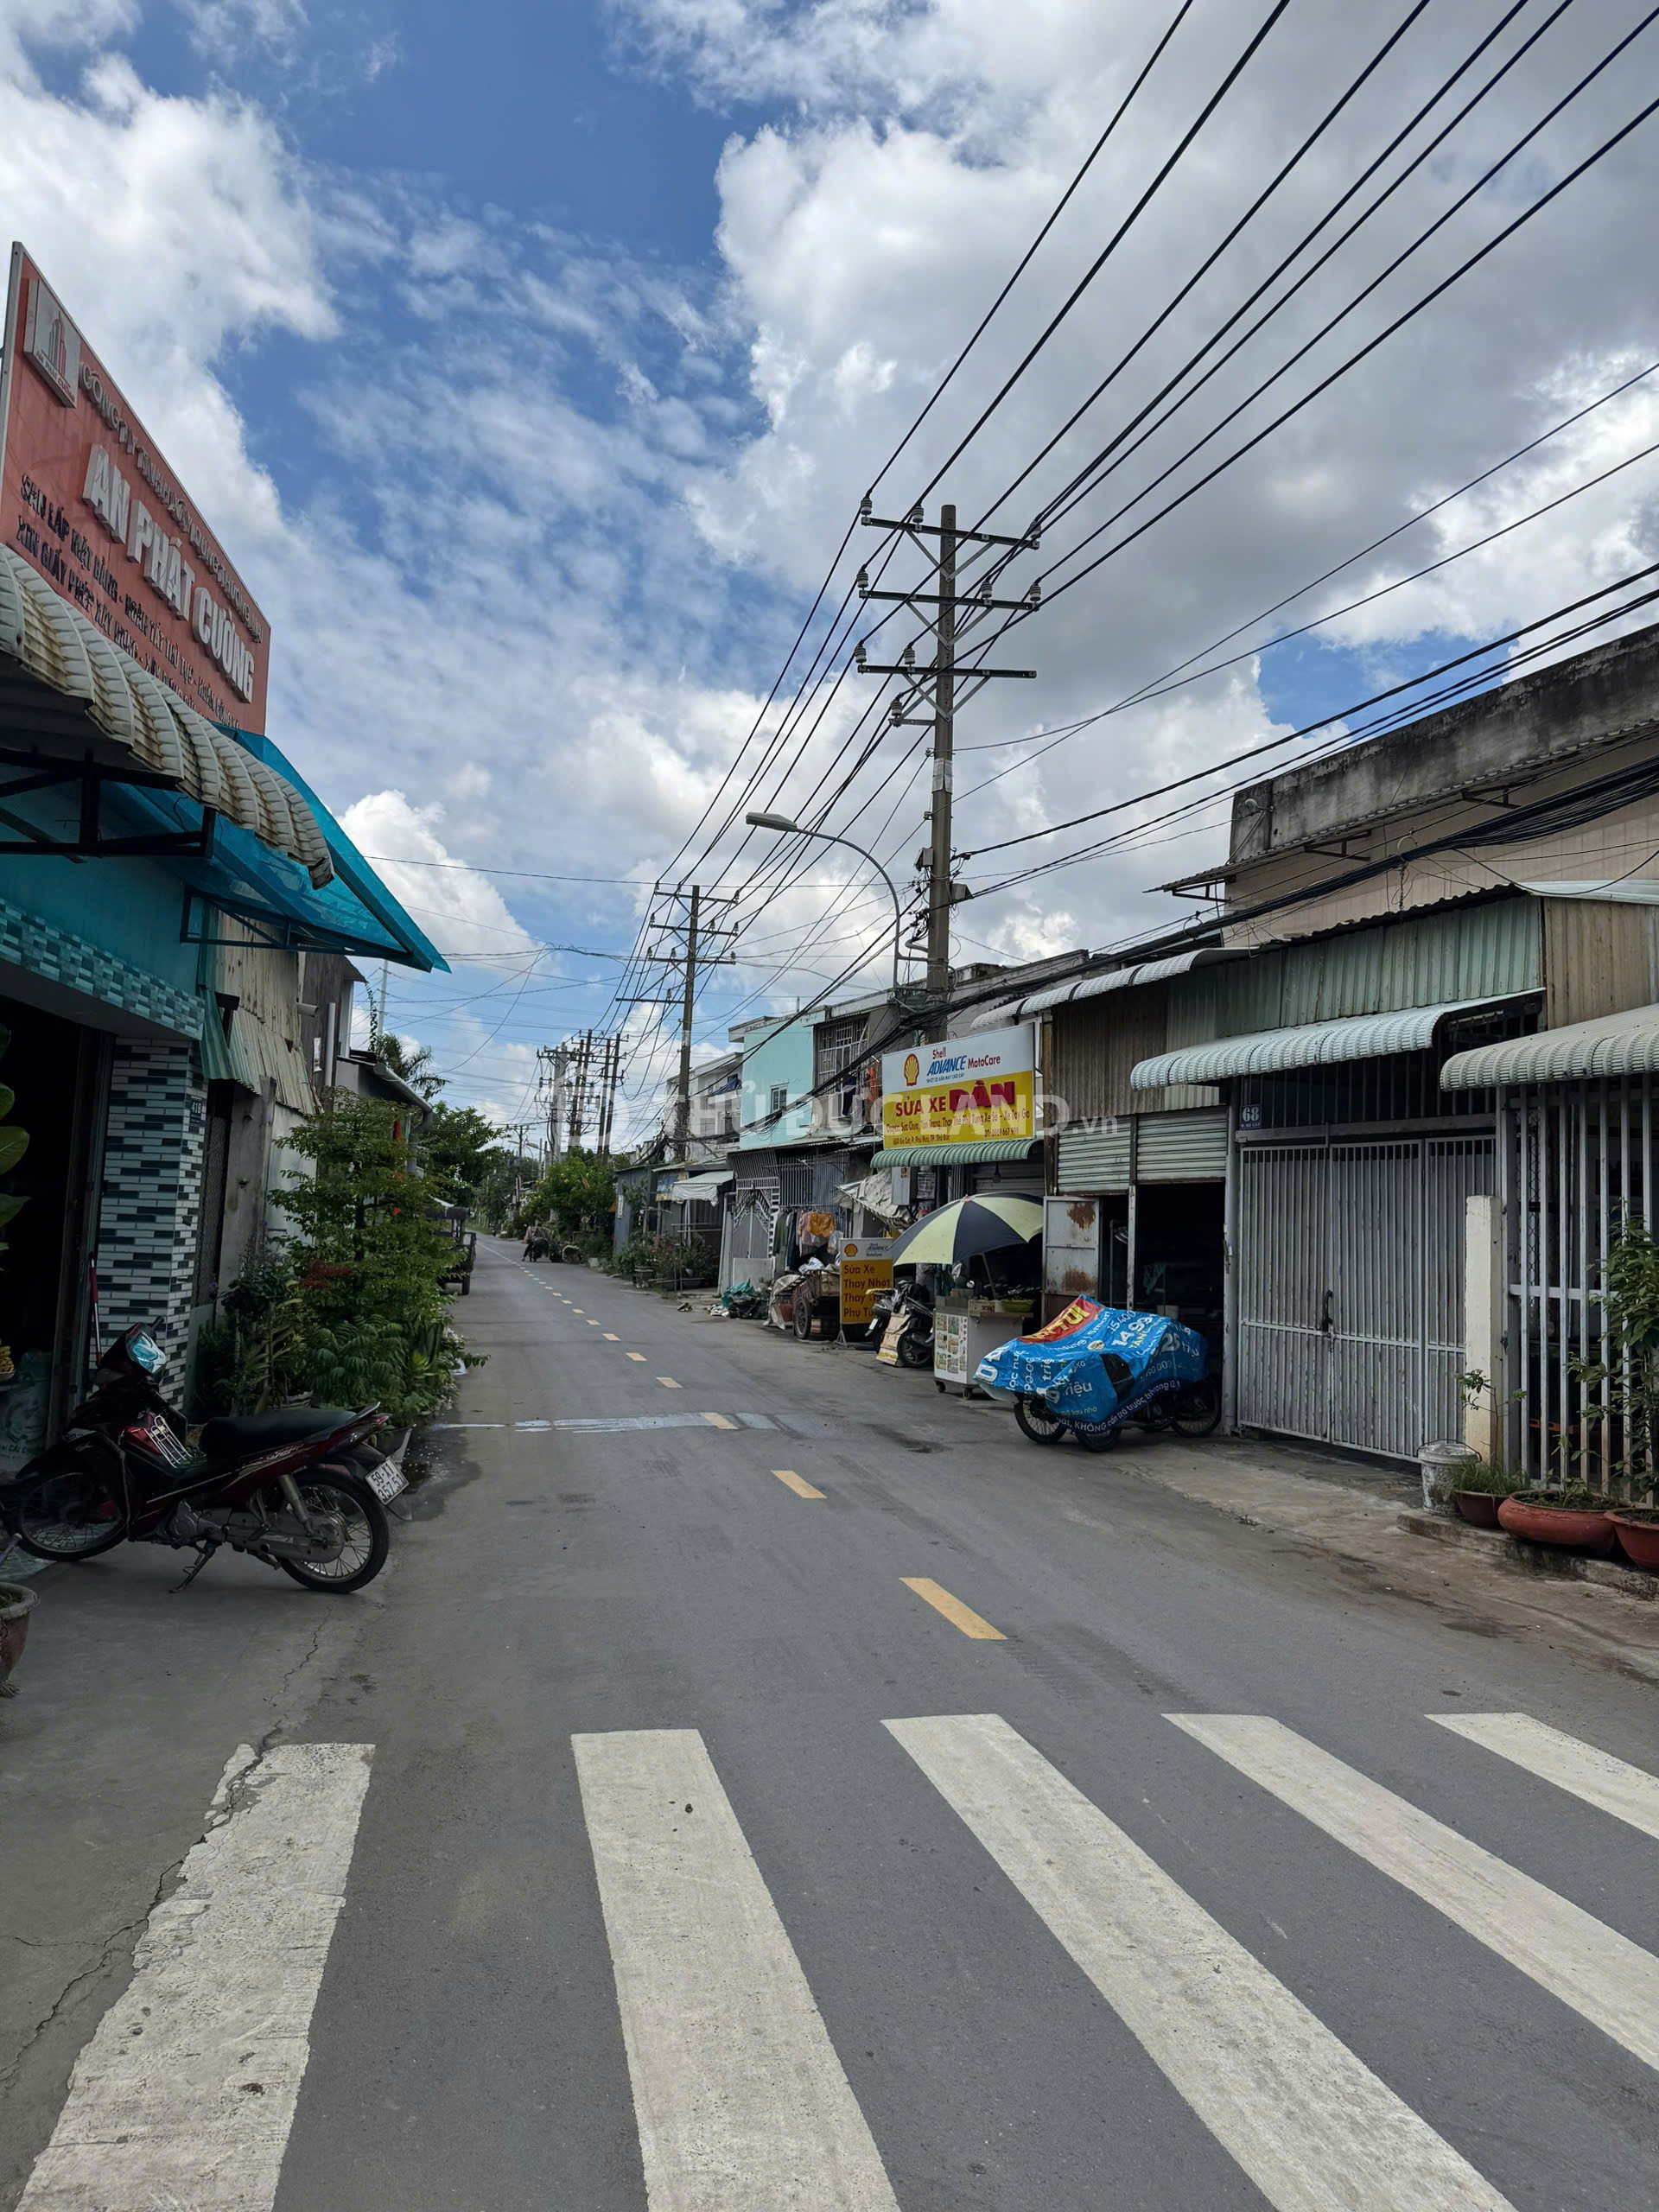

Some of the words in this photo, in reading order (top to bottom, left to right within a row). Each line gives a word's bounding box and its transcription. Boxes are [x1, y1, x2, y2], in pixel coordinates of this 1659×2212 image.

[79, 361, 119, 432] CÔNG
[82, 442, 131, 544] AN
[127, 499, 195, 622] PHÁT
[192, 587, 255, 704] CƯỜNG
[932, 1046, 947, 1059] Shell
[926, 1055, 968, 1077] ADVANCE
[967, 1055, 1001, 1070] MotoCare
[895, 1096, 922, 1117] SỬA
[929, 1096, 947, 1114] XE
[949, 1079, 1016, 1112] DÂN
[1021, 1107, 1030, 1119] Ga
[1242, 1106, 1260, 1122] 68
[863, 1264, 876, 1274] Xe
[844, 1279, 865, 1290] Thay
[844, 1293, 865, 1305] Thay
[1074, 1420, 1107, 1433] KHÔNG
